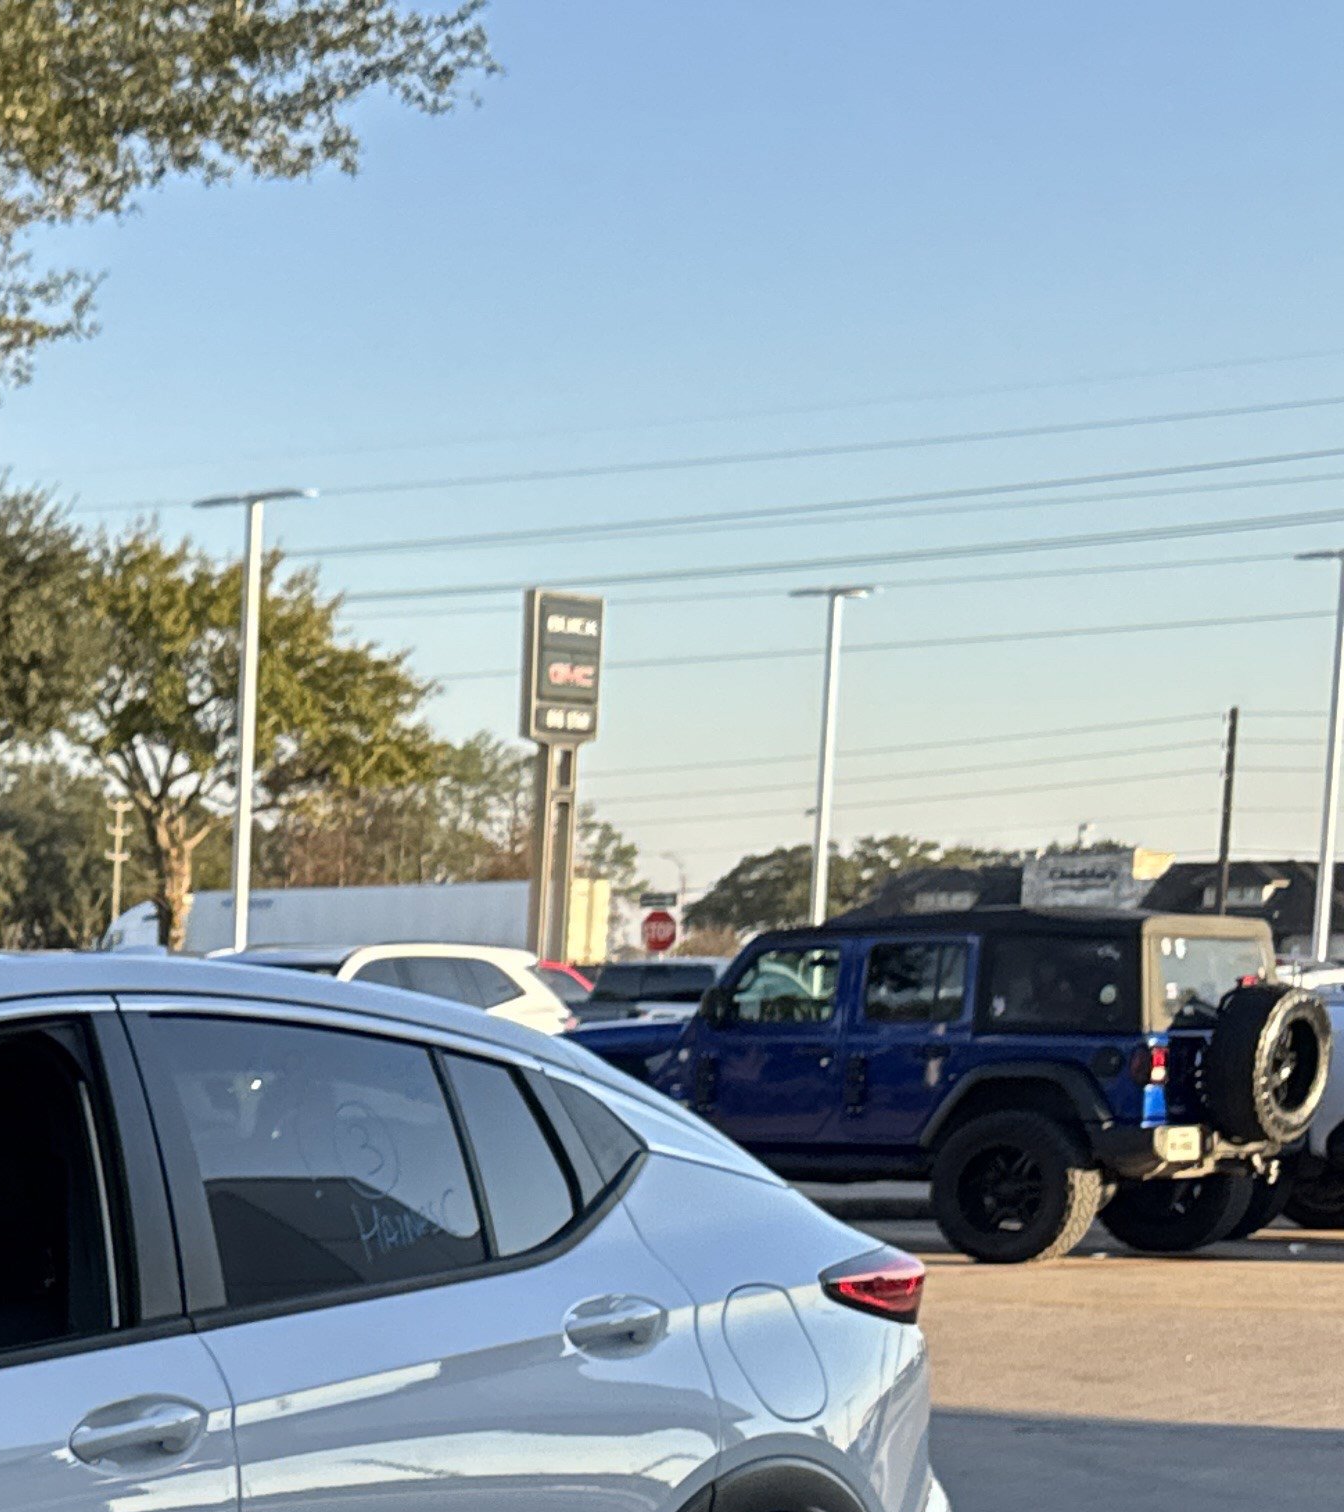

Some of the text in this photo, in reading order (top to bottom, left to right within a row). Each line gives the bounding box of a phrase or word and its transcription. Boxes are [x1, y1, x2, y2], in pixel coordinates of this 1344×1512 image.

[547, 615, 598, 636] BUICK
[549, 663, 594, 688] GMC
[645, 920, 675, 941] STOP
